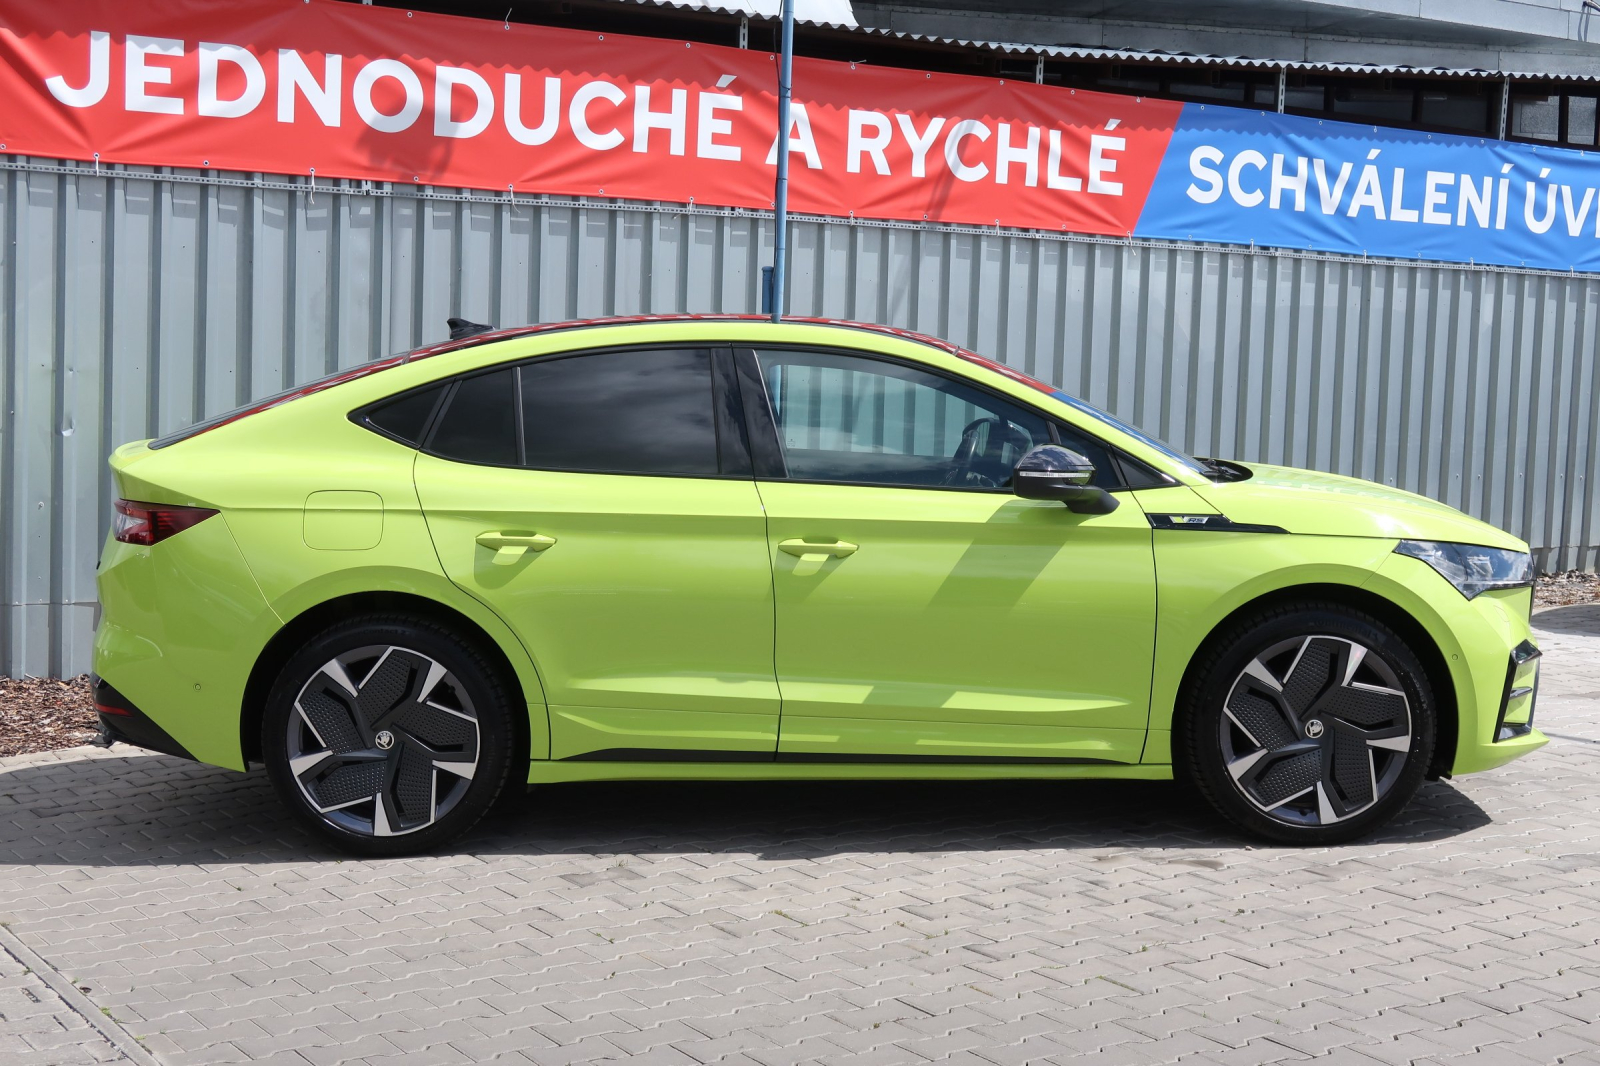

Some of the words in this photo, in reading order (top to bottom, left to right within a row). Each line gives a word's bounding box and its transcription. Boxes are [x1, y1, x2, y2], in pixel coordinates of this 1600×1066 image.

[45, 30, 744, 162] JEDNODUCHÉ
[764, 102, 823, 170] A
[846, 108, 1127, 197] RYCHLÉ
[1185, 145, 1515, 230] SCHVÁLENÍ
[1523, 167, 1600, 239] ÚV
